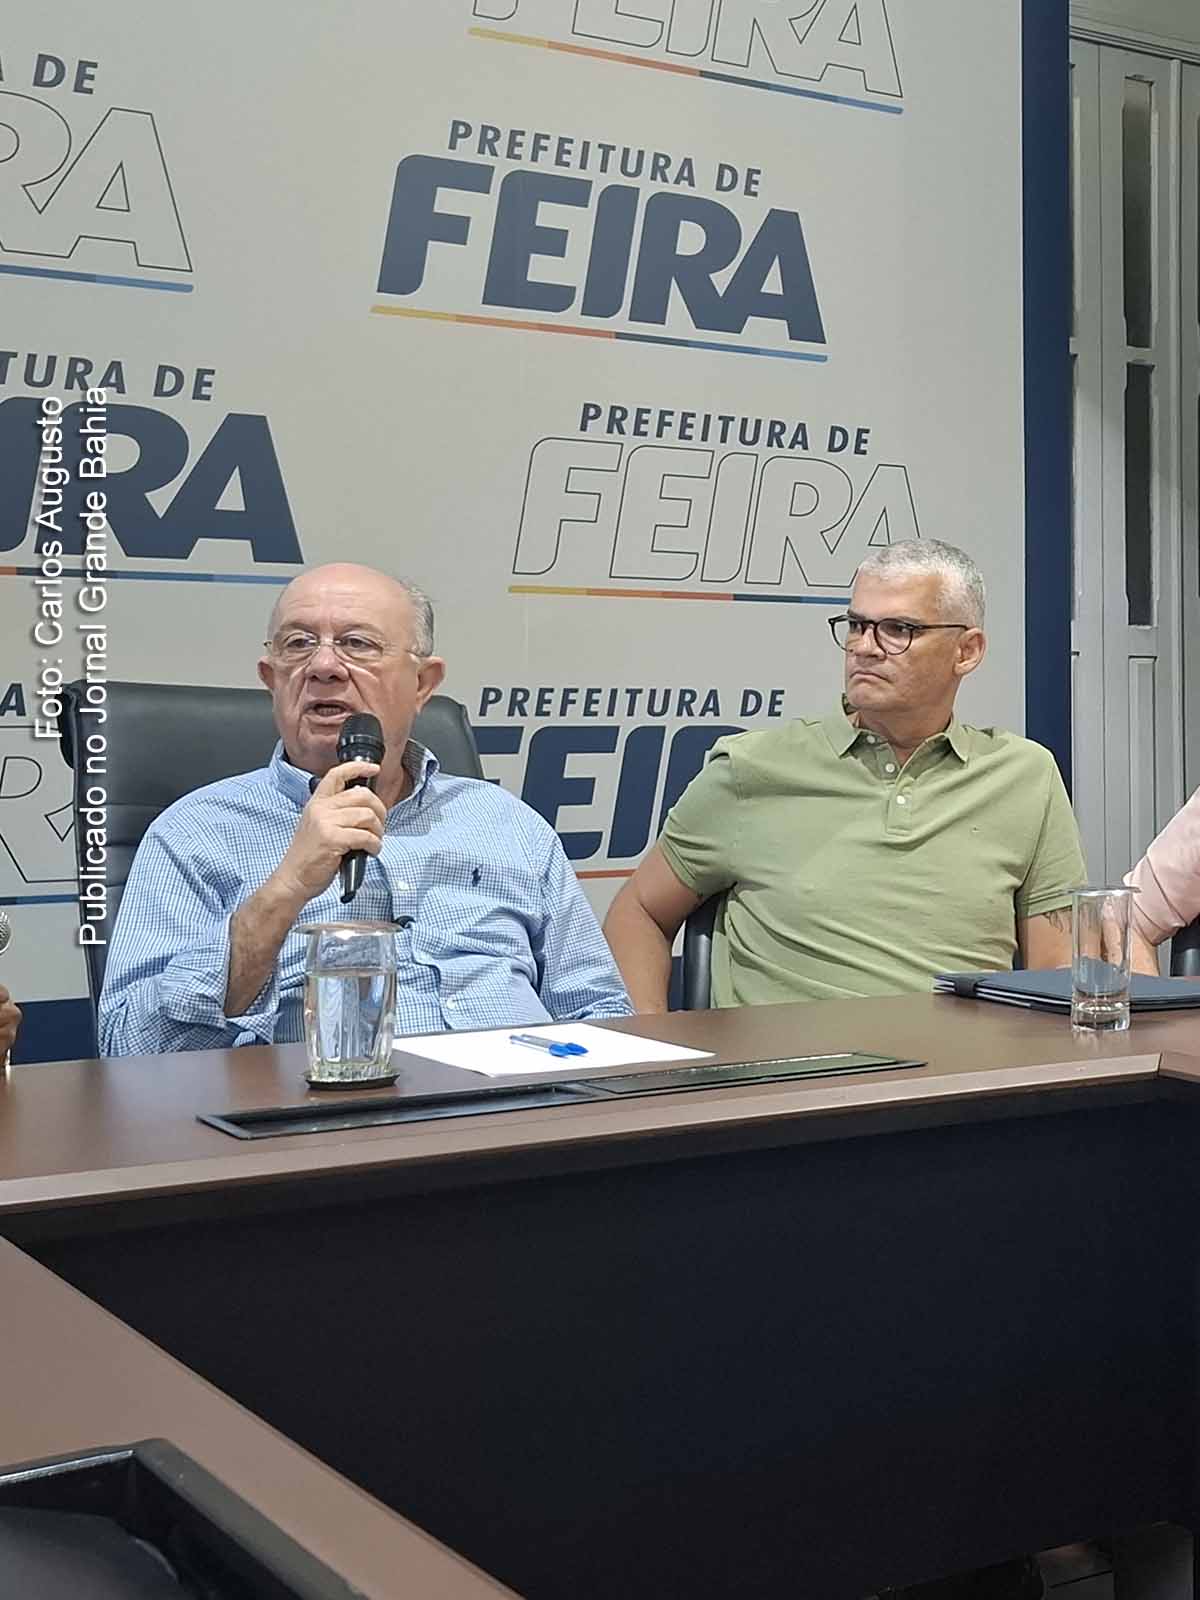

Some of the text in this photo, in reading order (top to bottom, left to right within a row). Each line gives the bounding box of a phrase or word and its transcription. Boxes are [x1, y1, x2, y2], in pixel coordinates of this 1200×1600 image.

[33, 53, 98, 94] DE
[448, 119, 762, 197] PREFEITURA DE
[376, 154, 827, 344] FEIRA
[153, 364, 216, 401] DE
[579, 403, 871, 455] PREFEITURA DE
[513, 437, 920, 588] FEIRA
[479, 687, 786, 718] PREFEITURA DE
